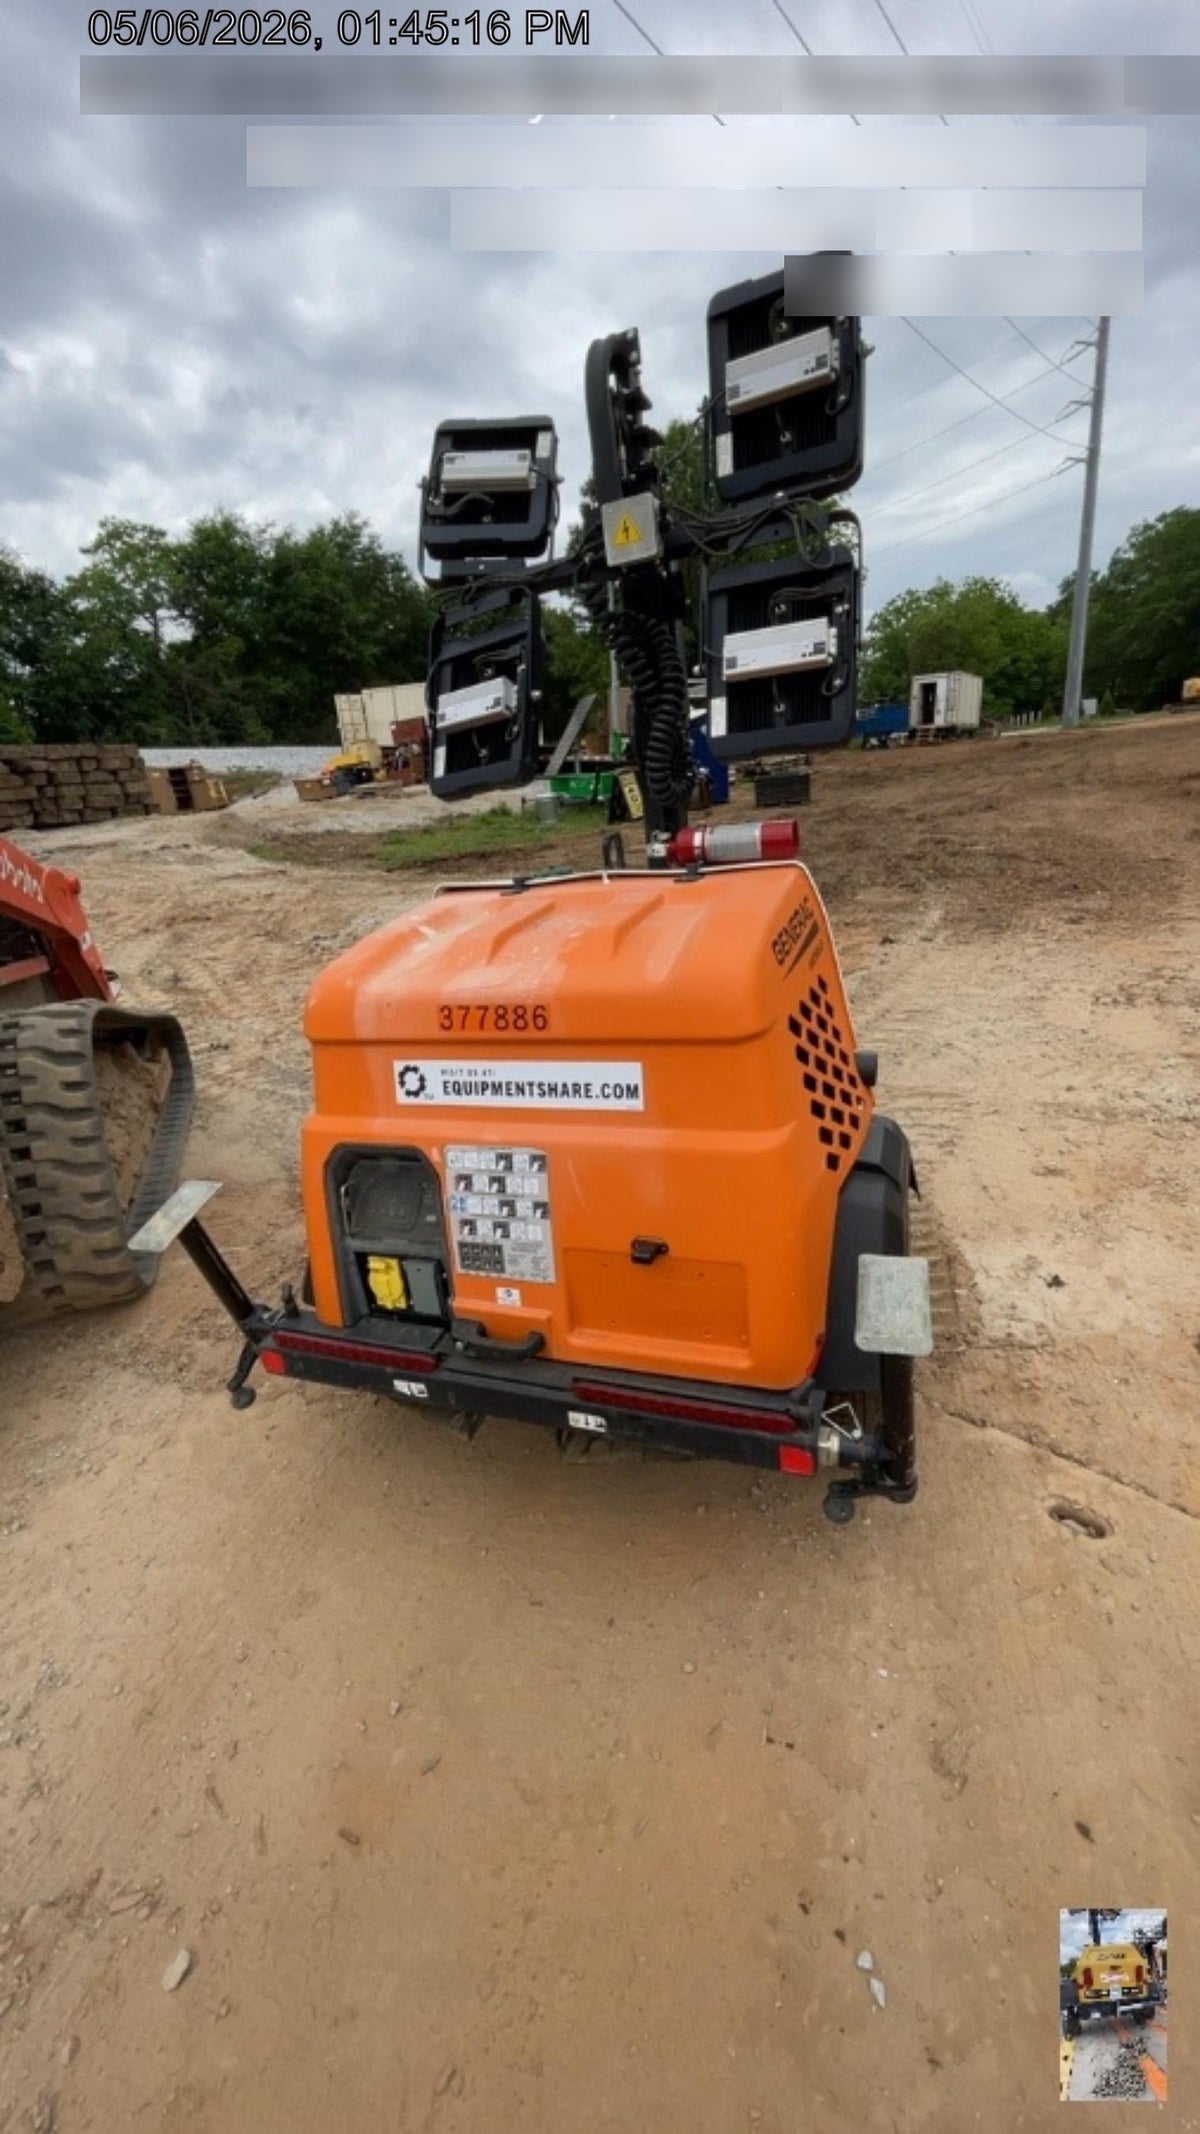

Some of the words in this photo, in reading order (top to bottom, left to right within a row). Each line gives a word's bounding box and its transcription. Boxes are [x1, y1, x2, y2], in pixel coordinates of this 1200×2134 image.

[772, 895, 814, 967] GENERAC
[440, 1004, 548, 1032] 377886
[442, 1080, 639, 1100] EQUIPMENTSHARE.COM
